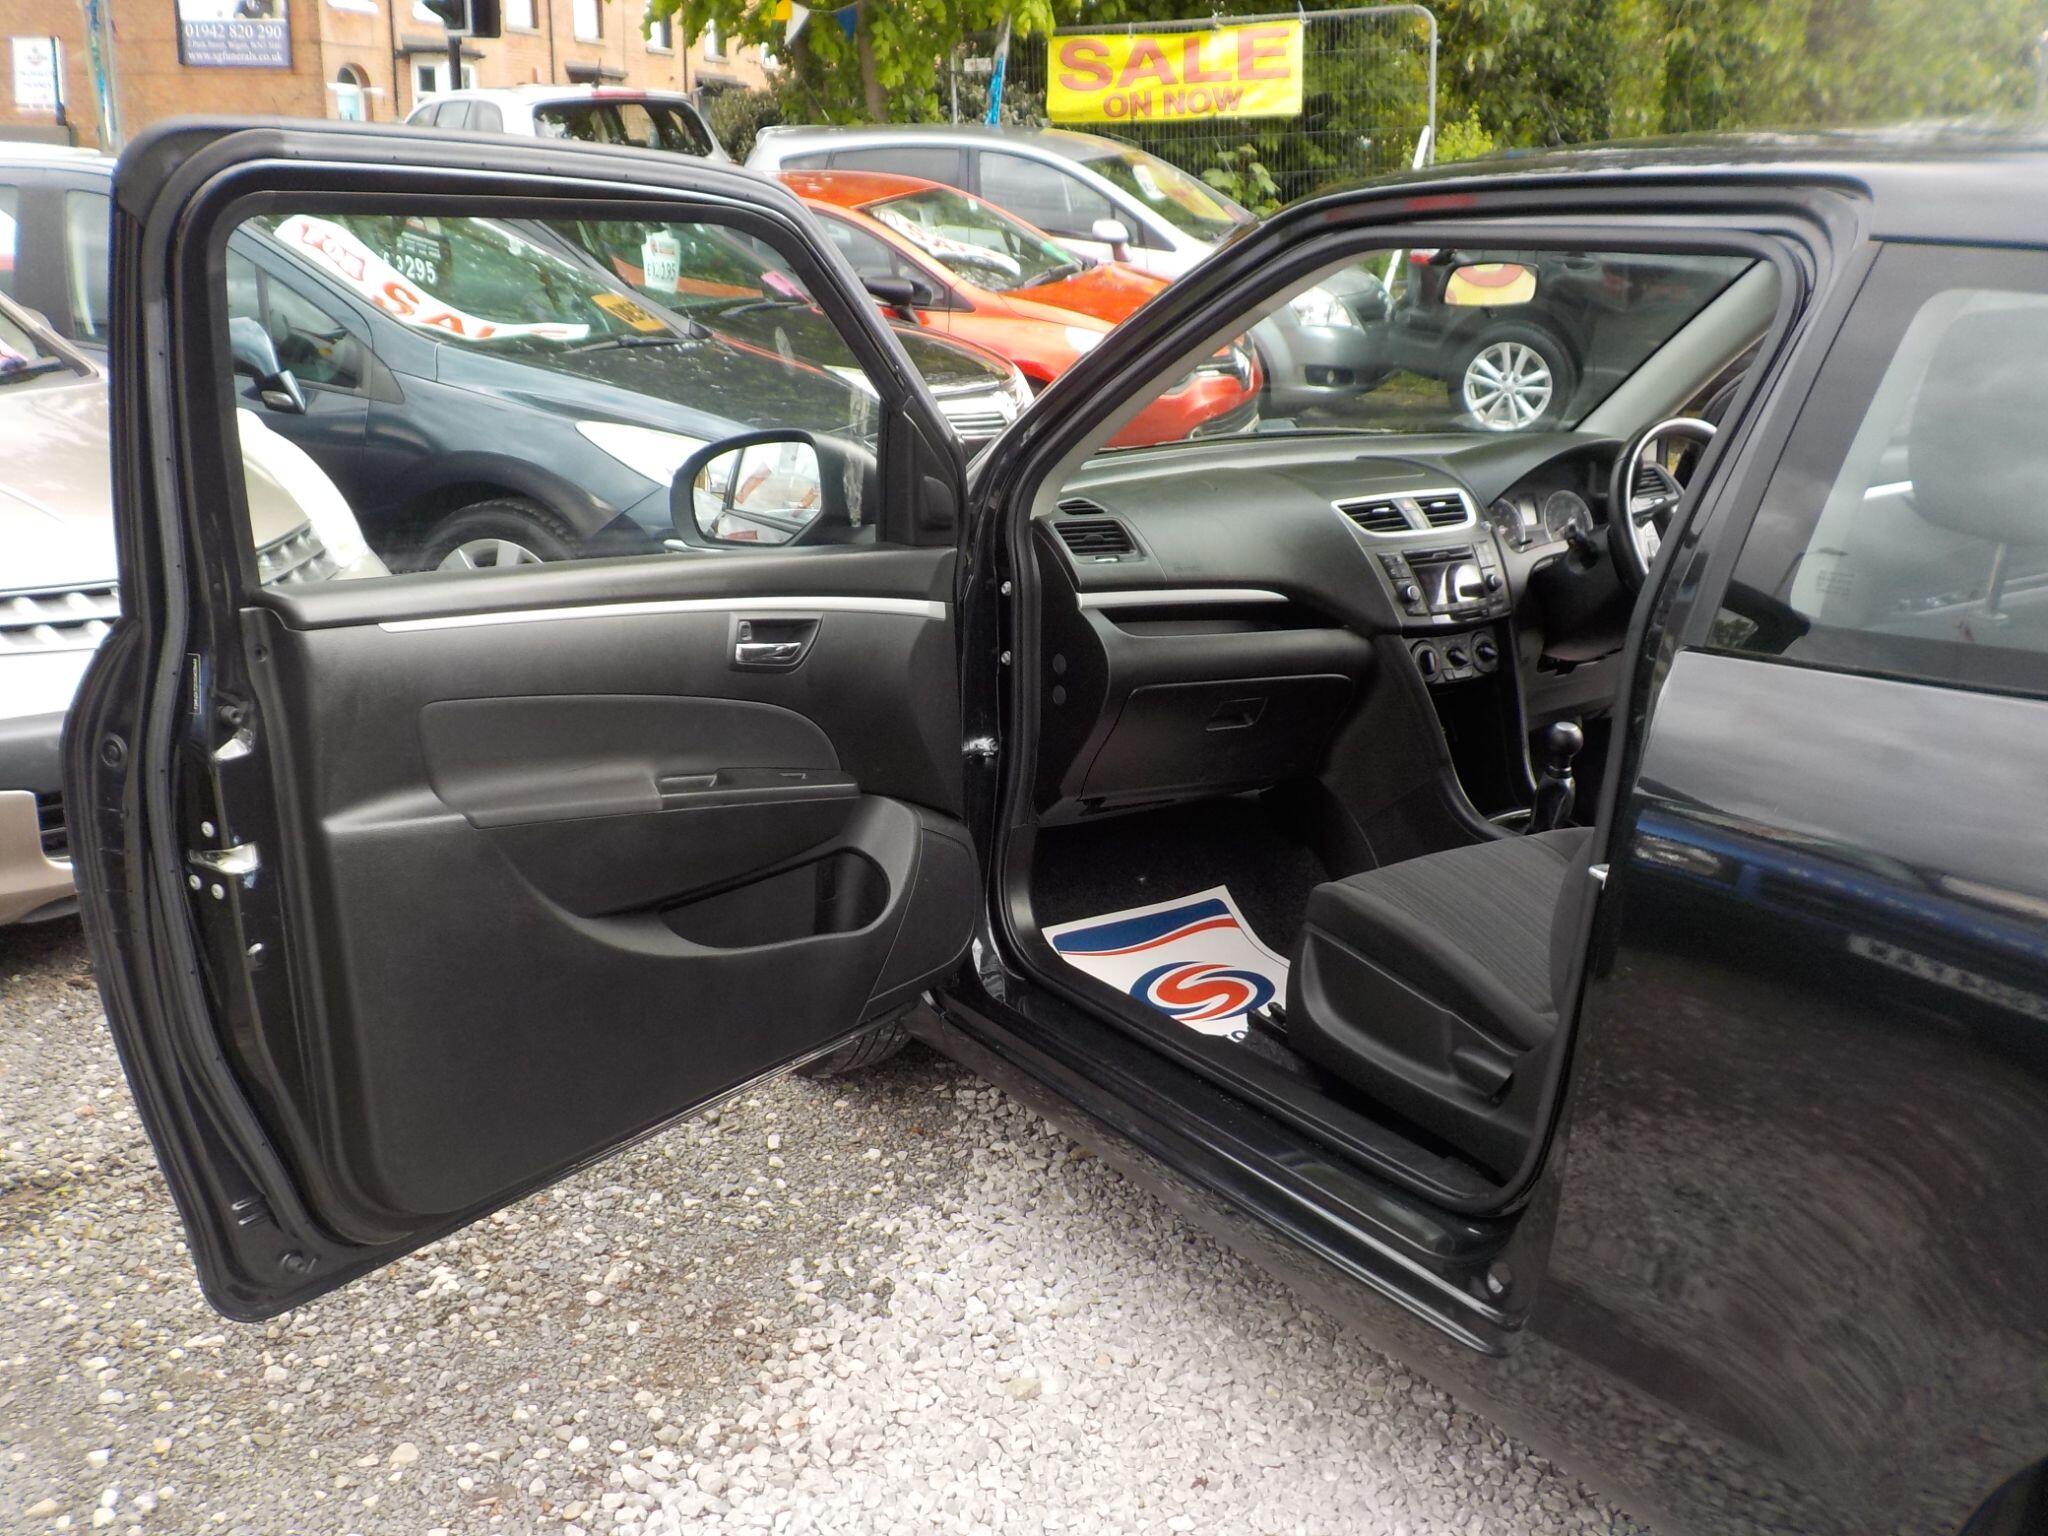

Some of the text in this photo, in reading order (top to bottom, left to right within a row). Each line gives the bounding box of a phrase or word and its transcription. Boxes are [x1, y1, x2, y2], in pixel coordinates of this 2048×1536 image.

[185, 23, 282, 39] 01942 820 290
[1059, 28, 1291, 91] SALE
[1103, 88, 1243, 118] ON NOW
